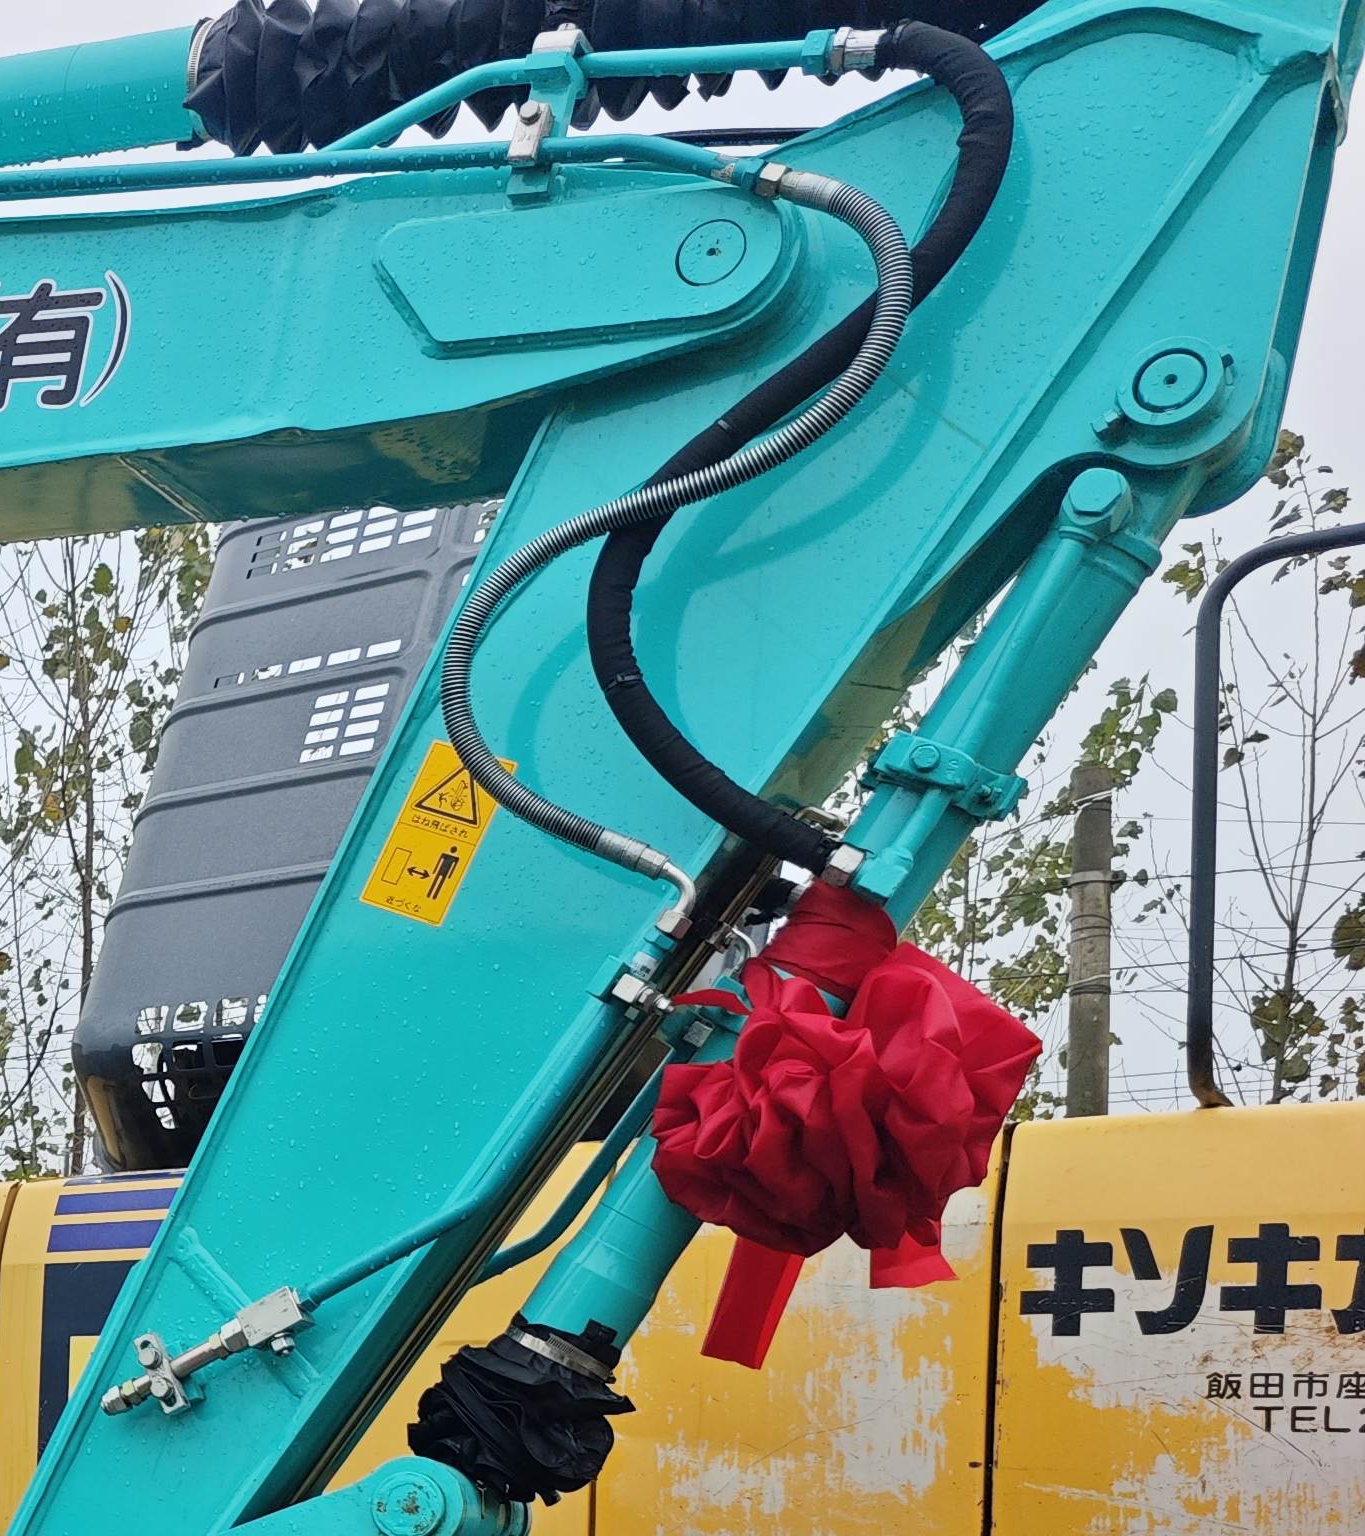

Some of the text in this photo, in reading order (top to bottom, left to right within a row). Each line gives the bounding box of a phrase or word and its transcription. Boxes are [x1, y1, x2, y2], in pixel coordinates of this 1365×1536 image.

[411, 814, 469, 839] はね飛ばされ
[1252, 1404, 1365, 1433] TEL
